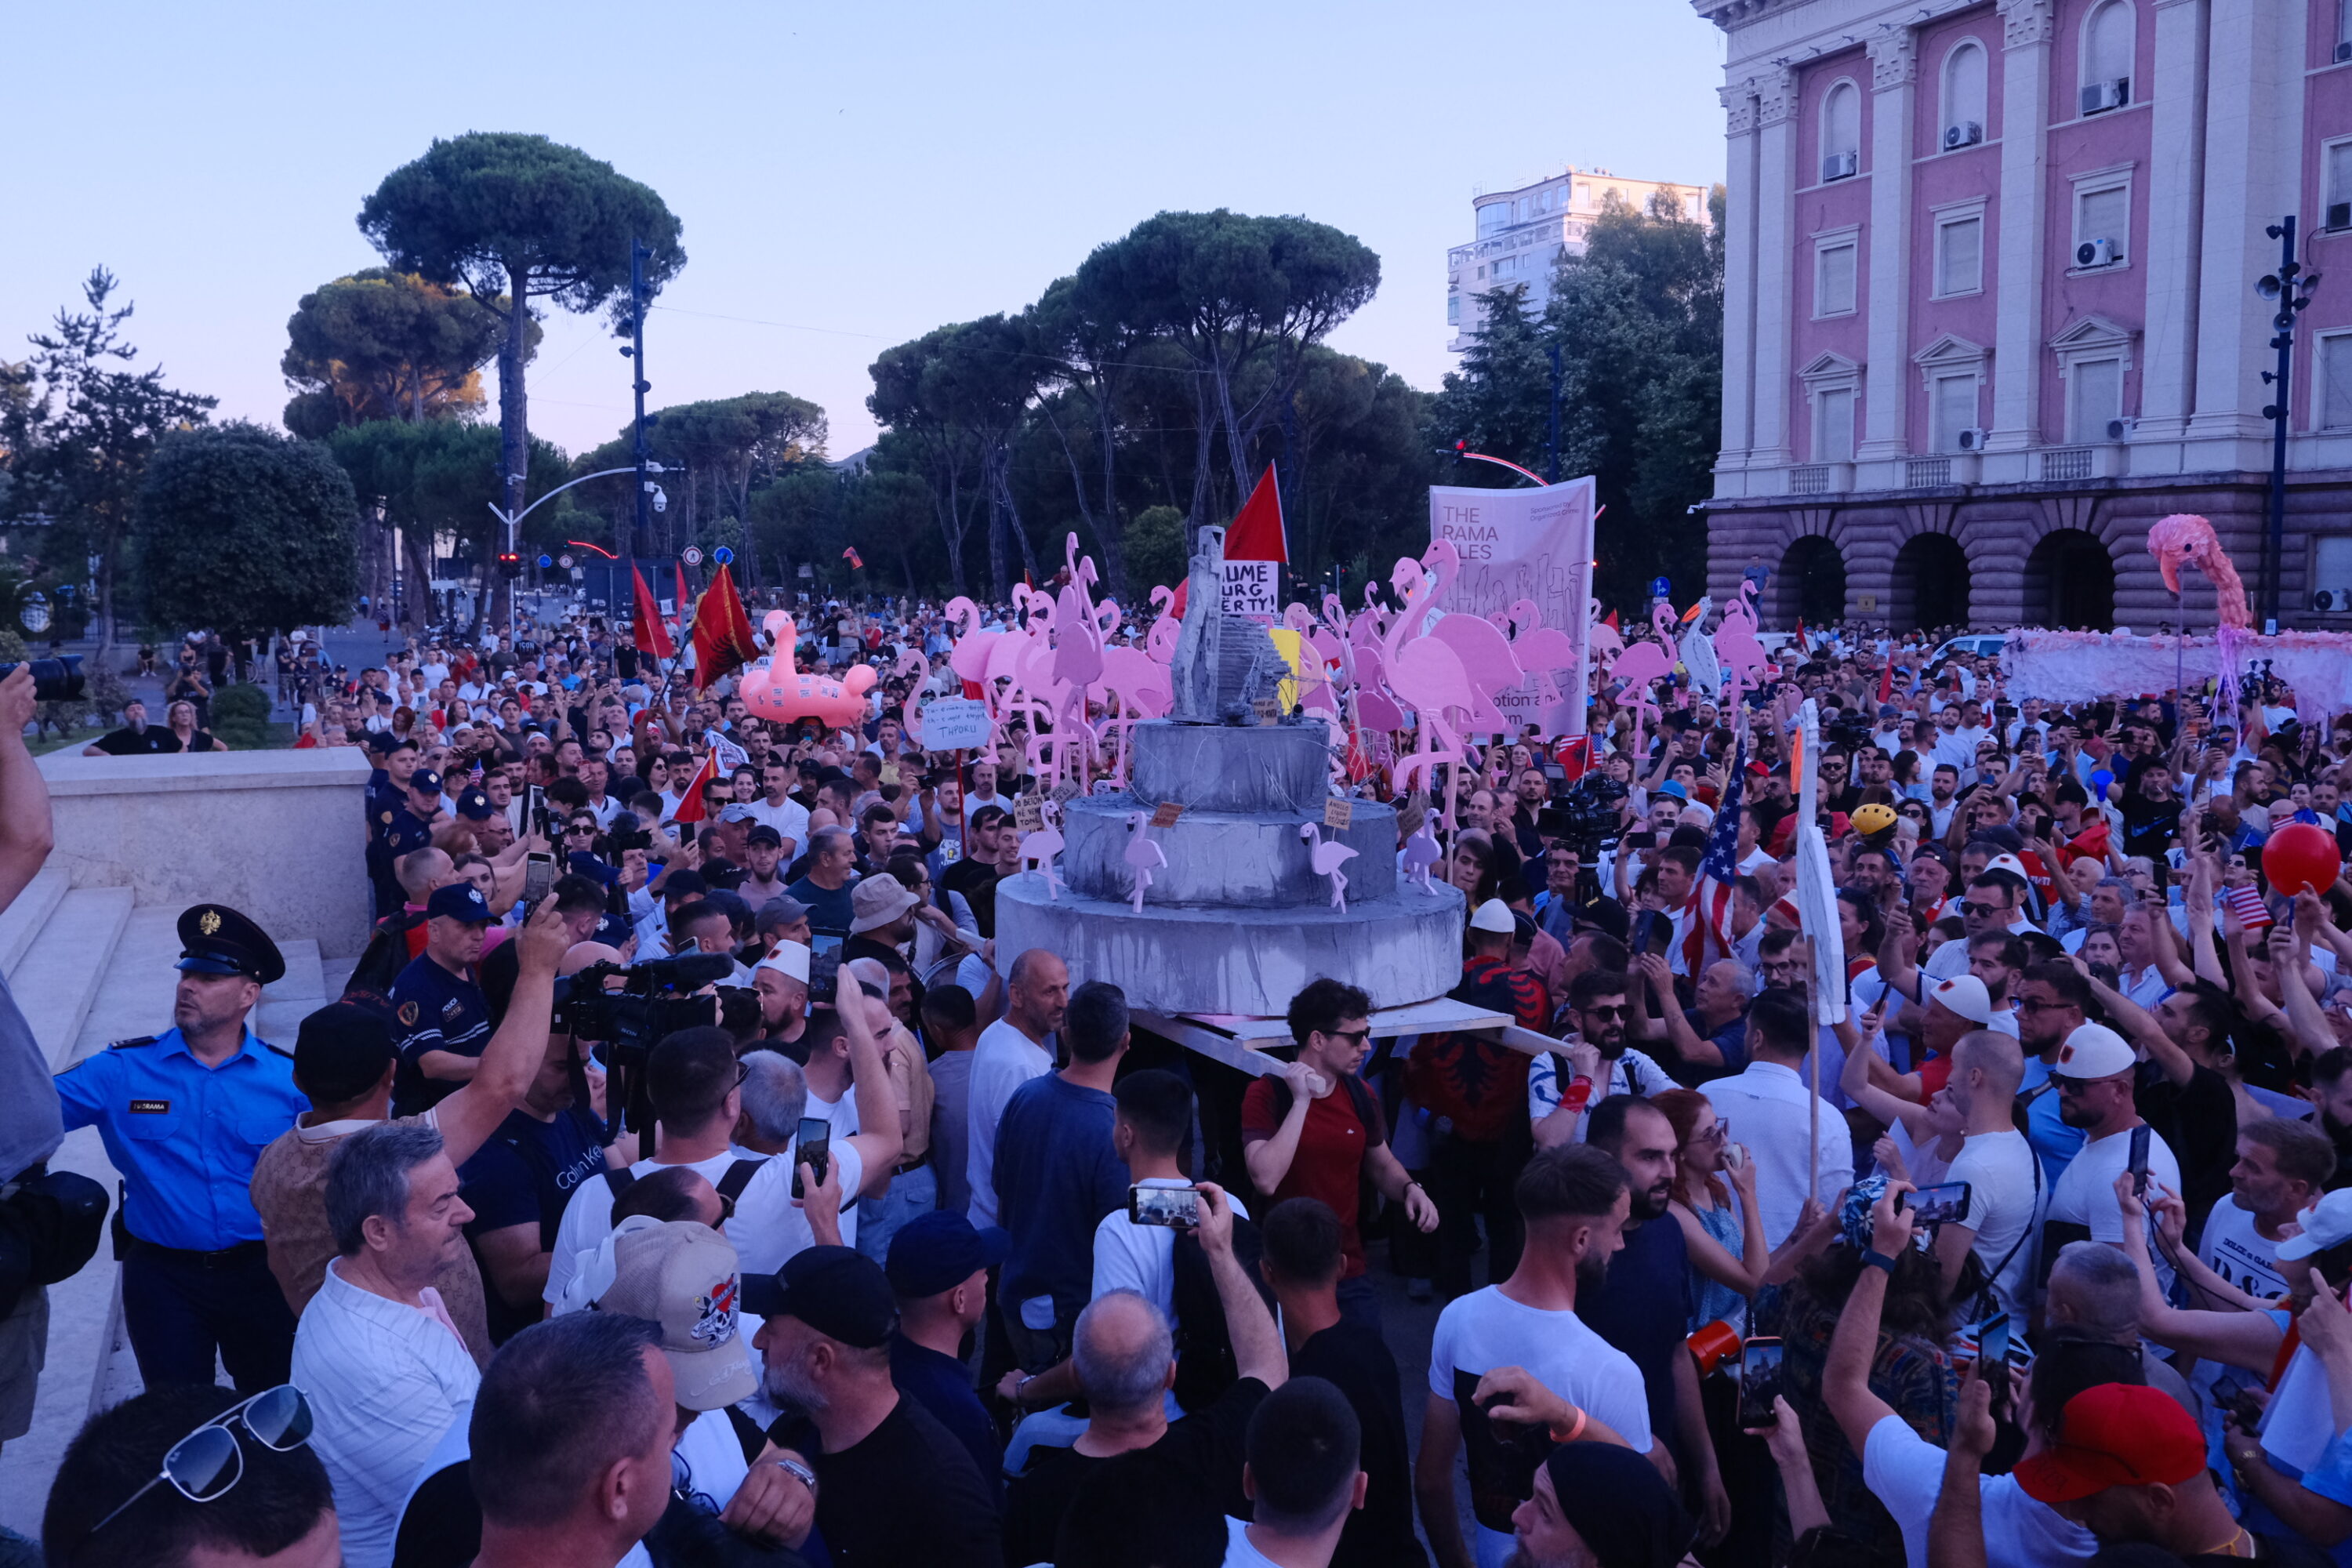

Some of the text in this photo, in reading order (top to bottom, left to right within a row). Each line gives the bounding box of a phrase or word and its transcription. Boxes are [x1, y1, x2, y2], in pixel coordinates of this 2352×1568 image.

[1443, 506, 1480, 523] THE
[1443, 524, 1498, 542] RAMA
[1454, 544, 1491, 560] LES
[1222, 561, 1269, 583] UMË
[621, 1027, 637, 1036] SONY
[2223, 1237, 2248, 1256] DOLCE
